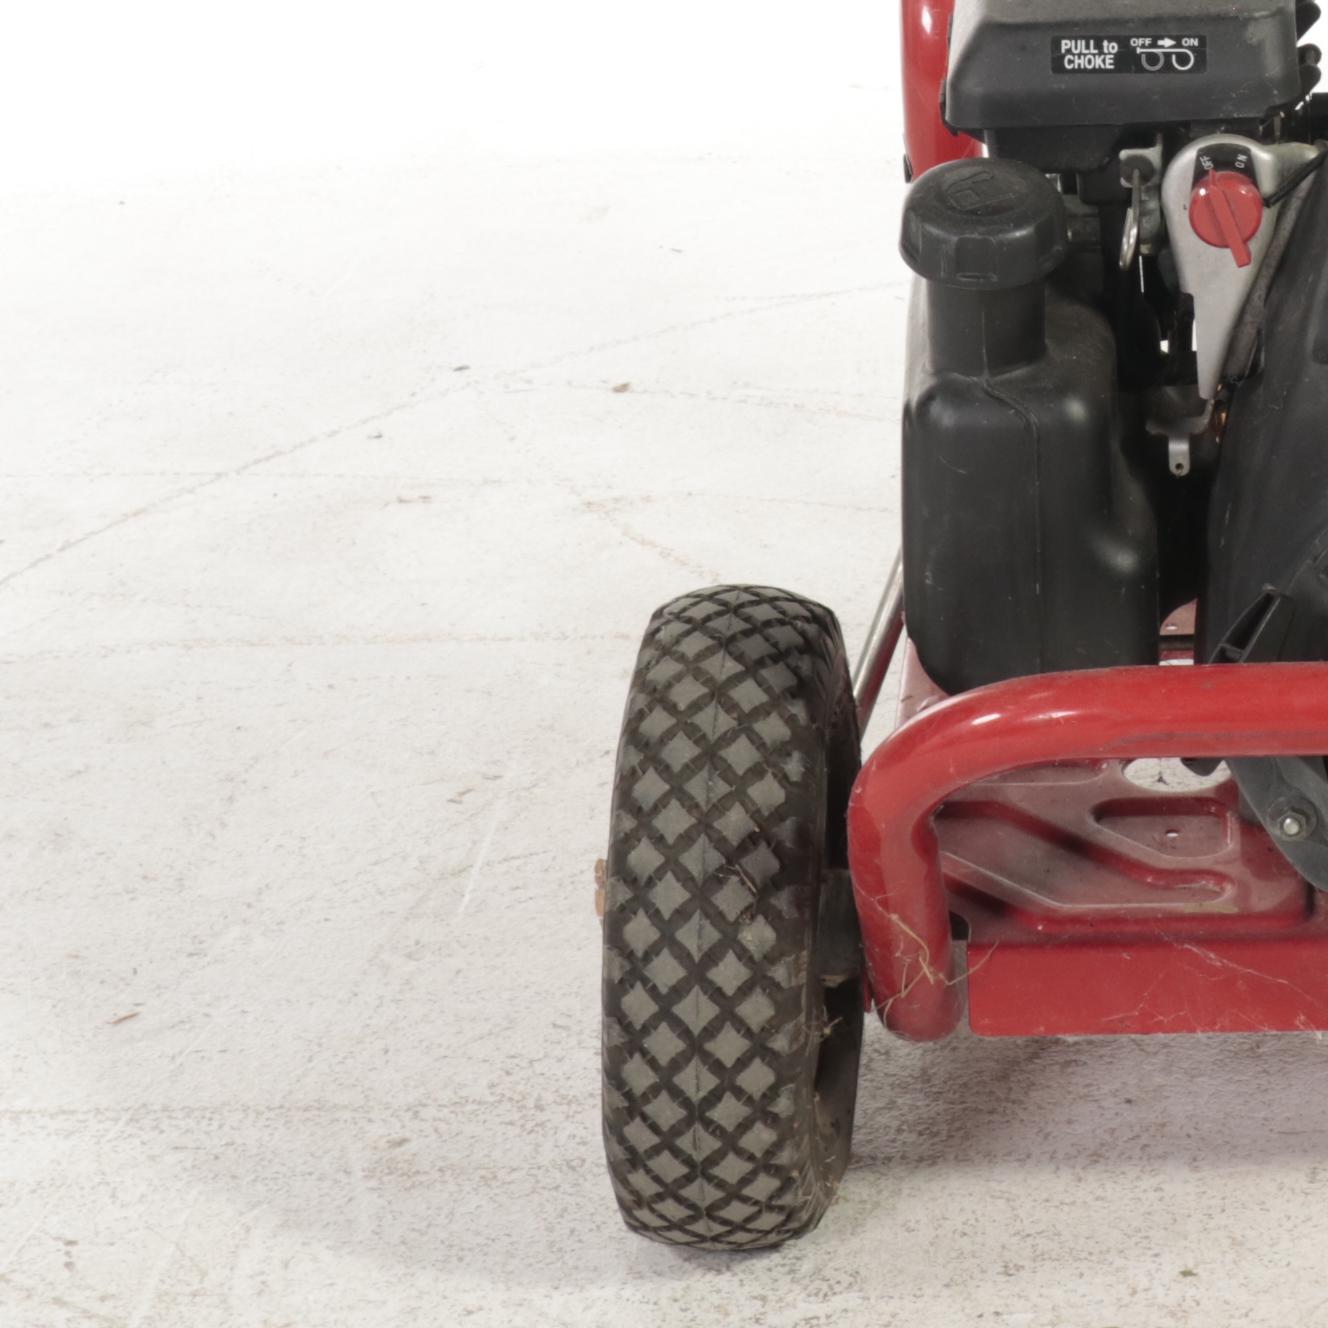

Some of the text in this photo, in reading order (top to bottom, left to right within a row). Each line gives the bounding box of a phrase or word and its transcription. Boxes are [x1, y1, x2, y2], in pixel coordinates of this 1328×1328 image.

[1061, 40, 1118, 53] PULL to
[1130, 38, 1198, 46] OFF ON
[1064, 55, 1114, 69] CHOKE
[1200, 155, 1214, 170] OFF
[1235, 154, 1248, 168] ON
